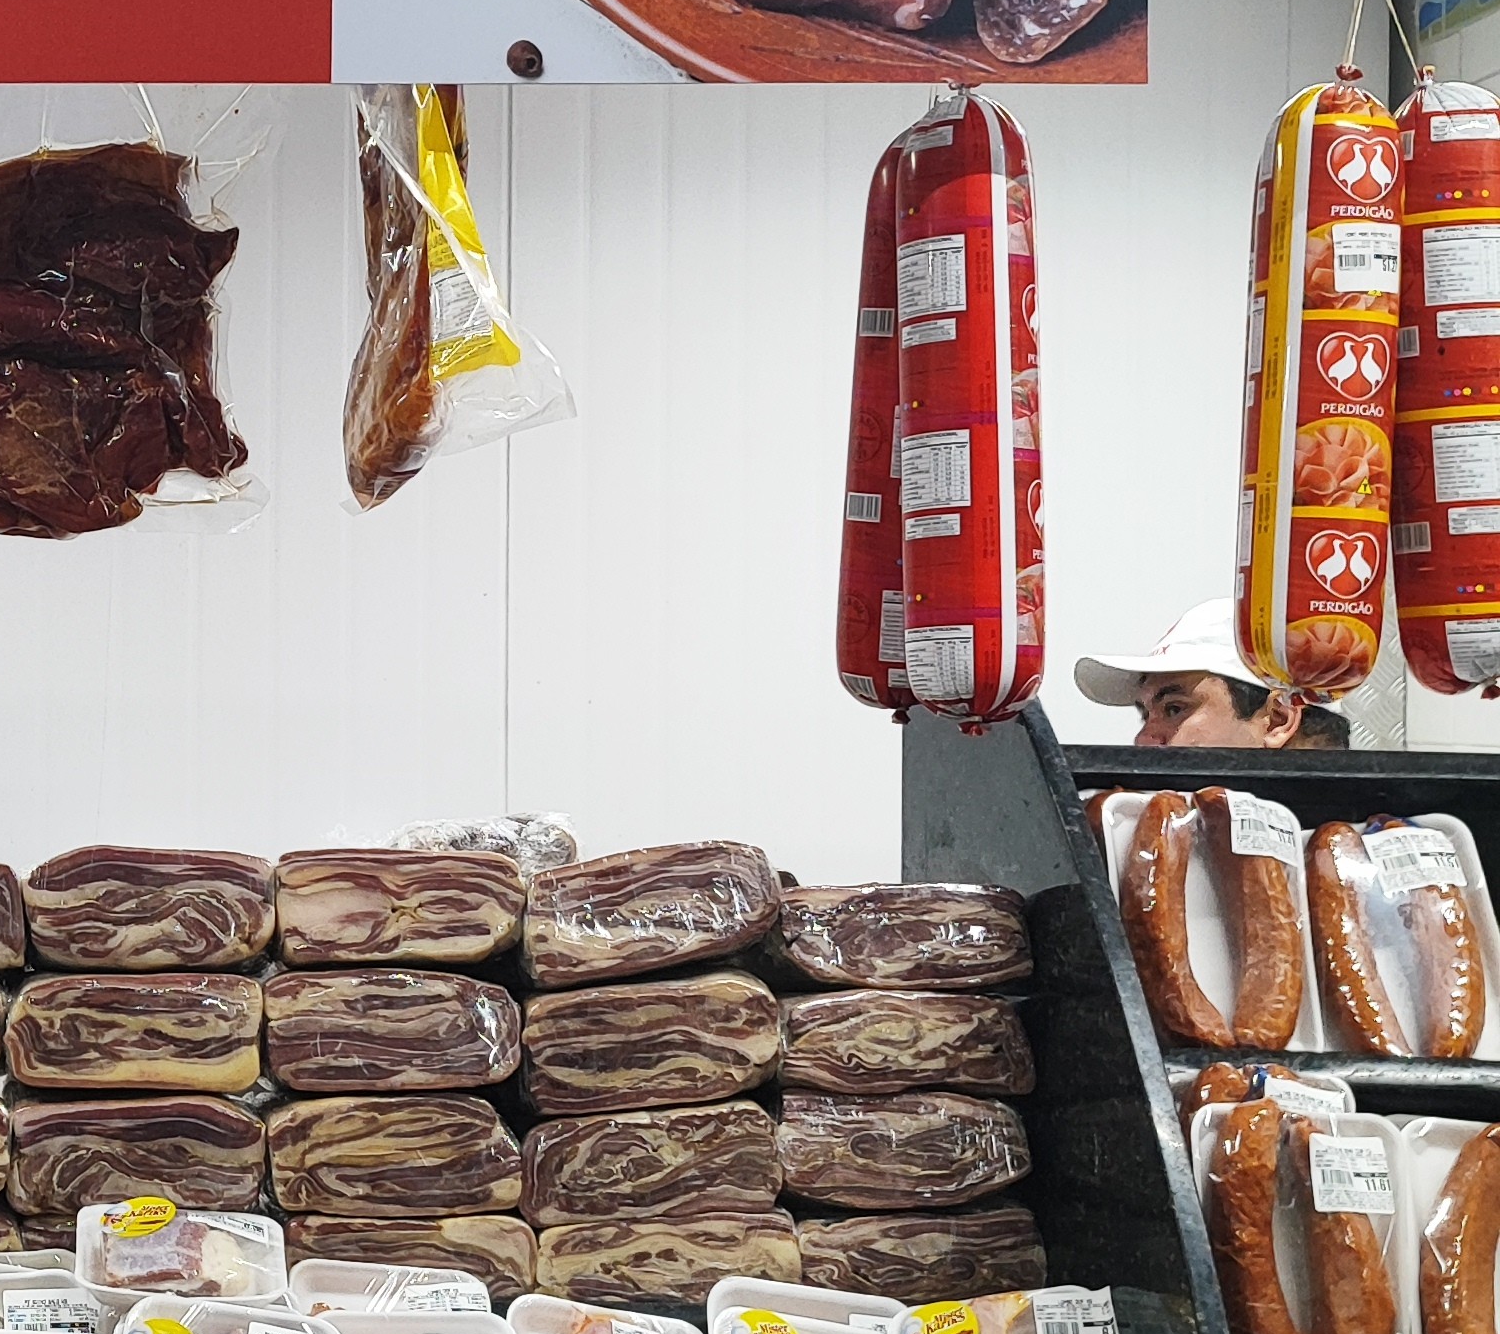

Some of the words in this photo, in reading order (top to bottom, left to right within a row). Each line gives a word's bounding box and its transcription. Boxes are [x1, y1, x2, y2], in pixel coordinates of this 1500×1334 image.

[1330, 205, 1394, 220] PERDIGÃO
[1320, 402, 1384, 418] PERDIGÃO
[1309, 600, 1373, 615] PERDIGÃO
